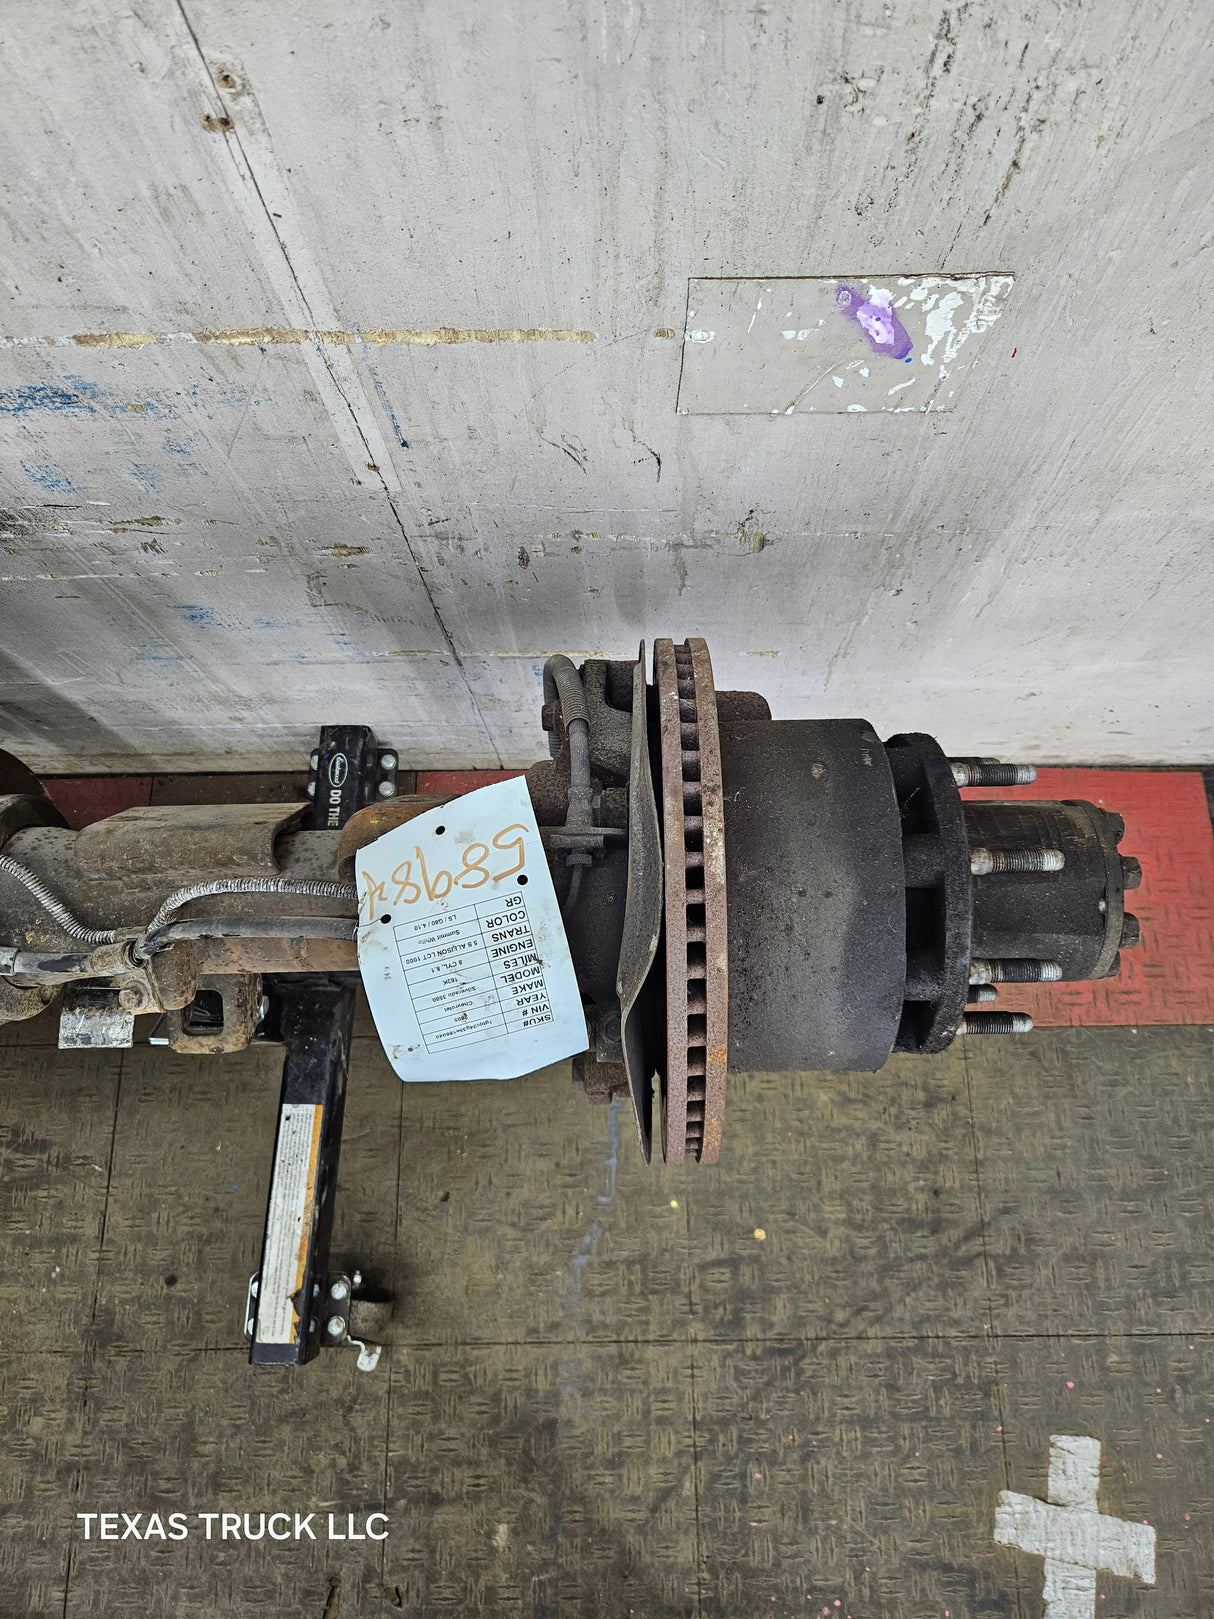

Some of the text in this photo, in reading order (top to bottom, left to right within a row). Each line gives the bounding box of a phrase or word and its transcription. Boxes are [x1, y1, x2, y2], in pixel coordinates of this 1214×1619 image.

[327, 789, 341, 827] DO THE
[505, 896, 522, 908] GR
[447, 914, 457, 922] LS
[413, 923, 427, 931] 4.10
[417, 910, 525, 945] COLOR Summit White
[491, 924, 530, 942] TRANS
[422, 951, 436, 960] LCT
[437, 943, 466, 957] ALLISON
[490, 939, 533, 958] ENGINE
[405, 956, 421, 965] 1000
[503, 952, 537, 969] MILES
[500, 966, 540, 984] MODEL
[443, 979, 544, 1012] MAKE Chevrolet
[447, 985, 476, 997] Silverado
[516, 992, 547, 1006] YEAR
[521, 1009, 528, 1017] #
[531, 1003, 549, 1014] VIN
[522, 1014, 552, 1028] SKU#
